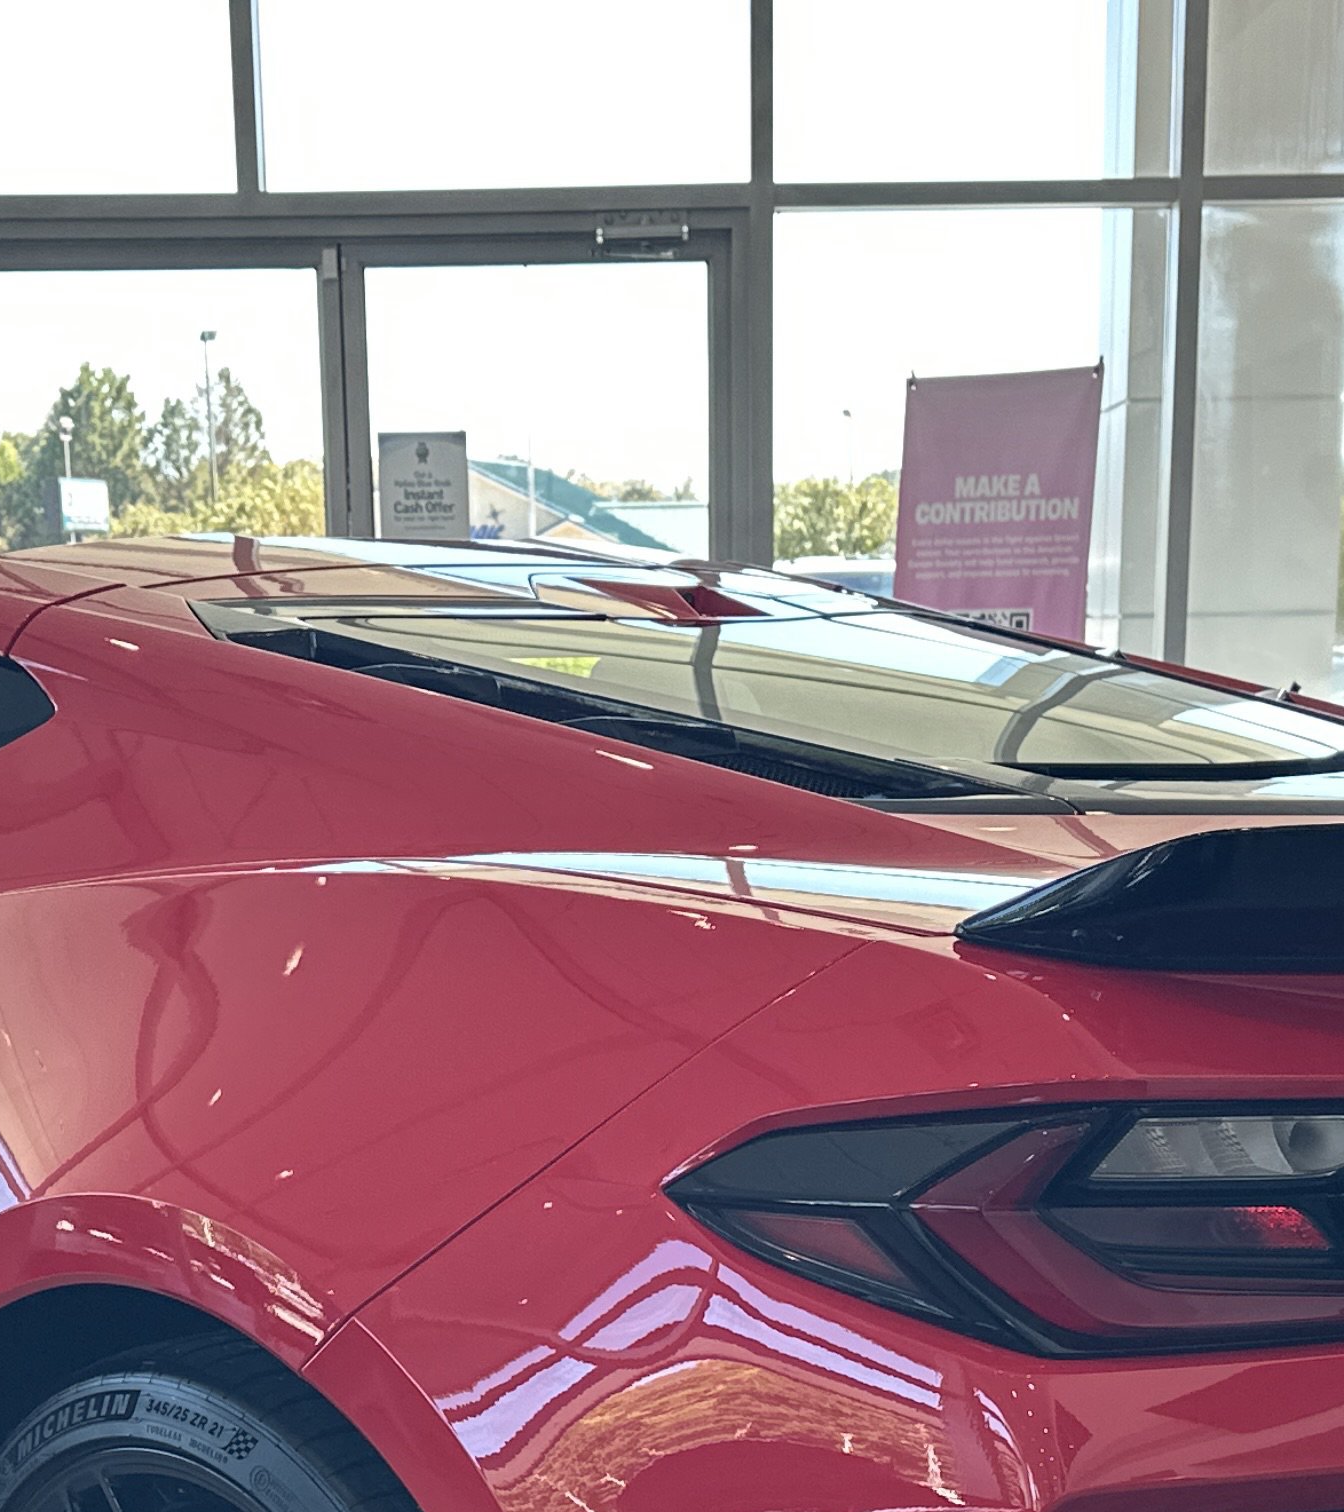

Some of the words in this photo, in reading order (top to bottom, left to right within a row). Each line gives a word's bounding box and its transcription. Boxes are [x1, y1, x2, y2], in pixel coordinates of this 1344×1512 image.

[403, 488, 444, 500] Instant
[954, 474, 1021, 498] MAKE
[1024, 472, 1041, 496] A
[393, 501, 423, 514] Cash
[425, 501, 455, 514] Offer
[915, 497, 1079, 525] CONTRIBUTION
[16, 1393, 130, 1461] MICHELIN
[145, 1398, 190, 1422] 345/25
[189, 1412, 209, 1431] ZR
[208, 1421, 224, 1438] 21
